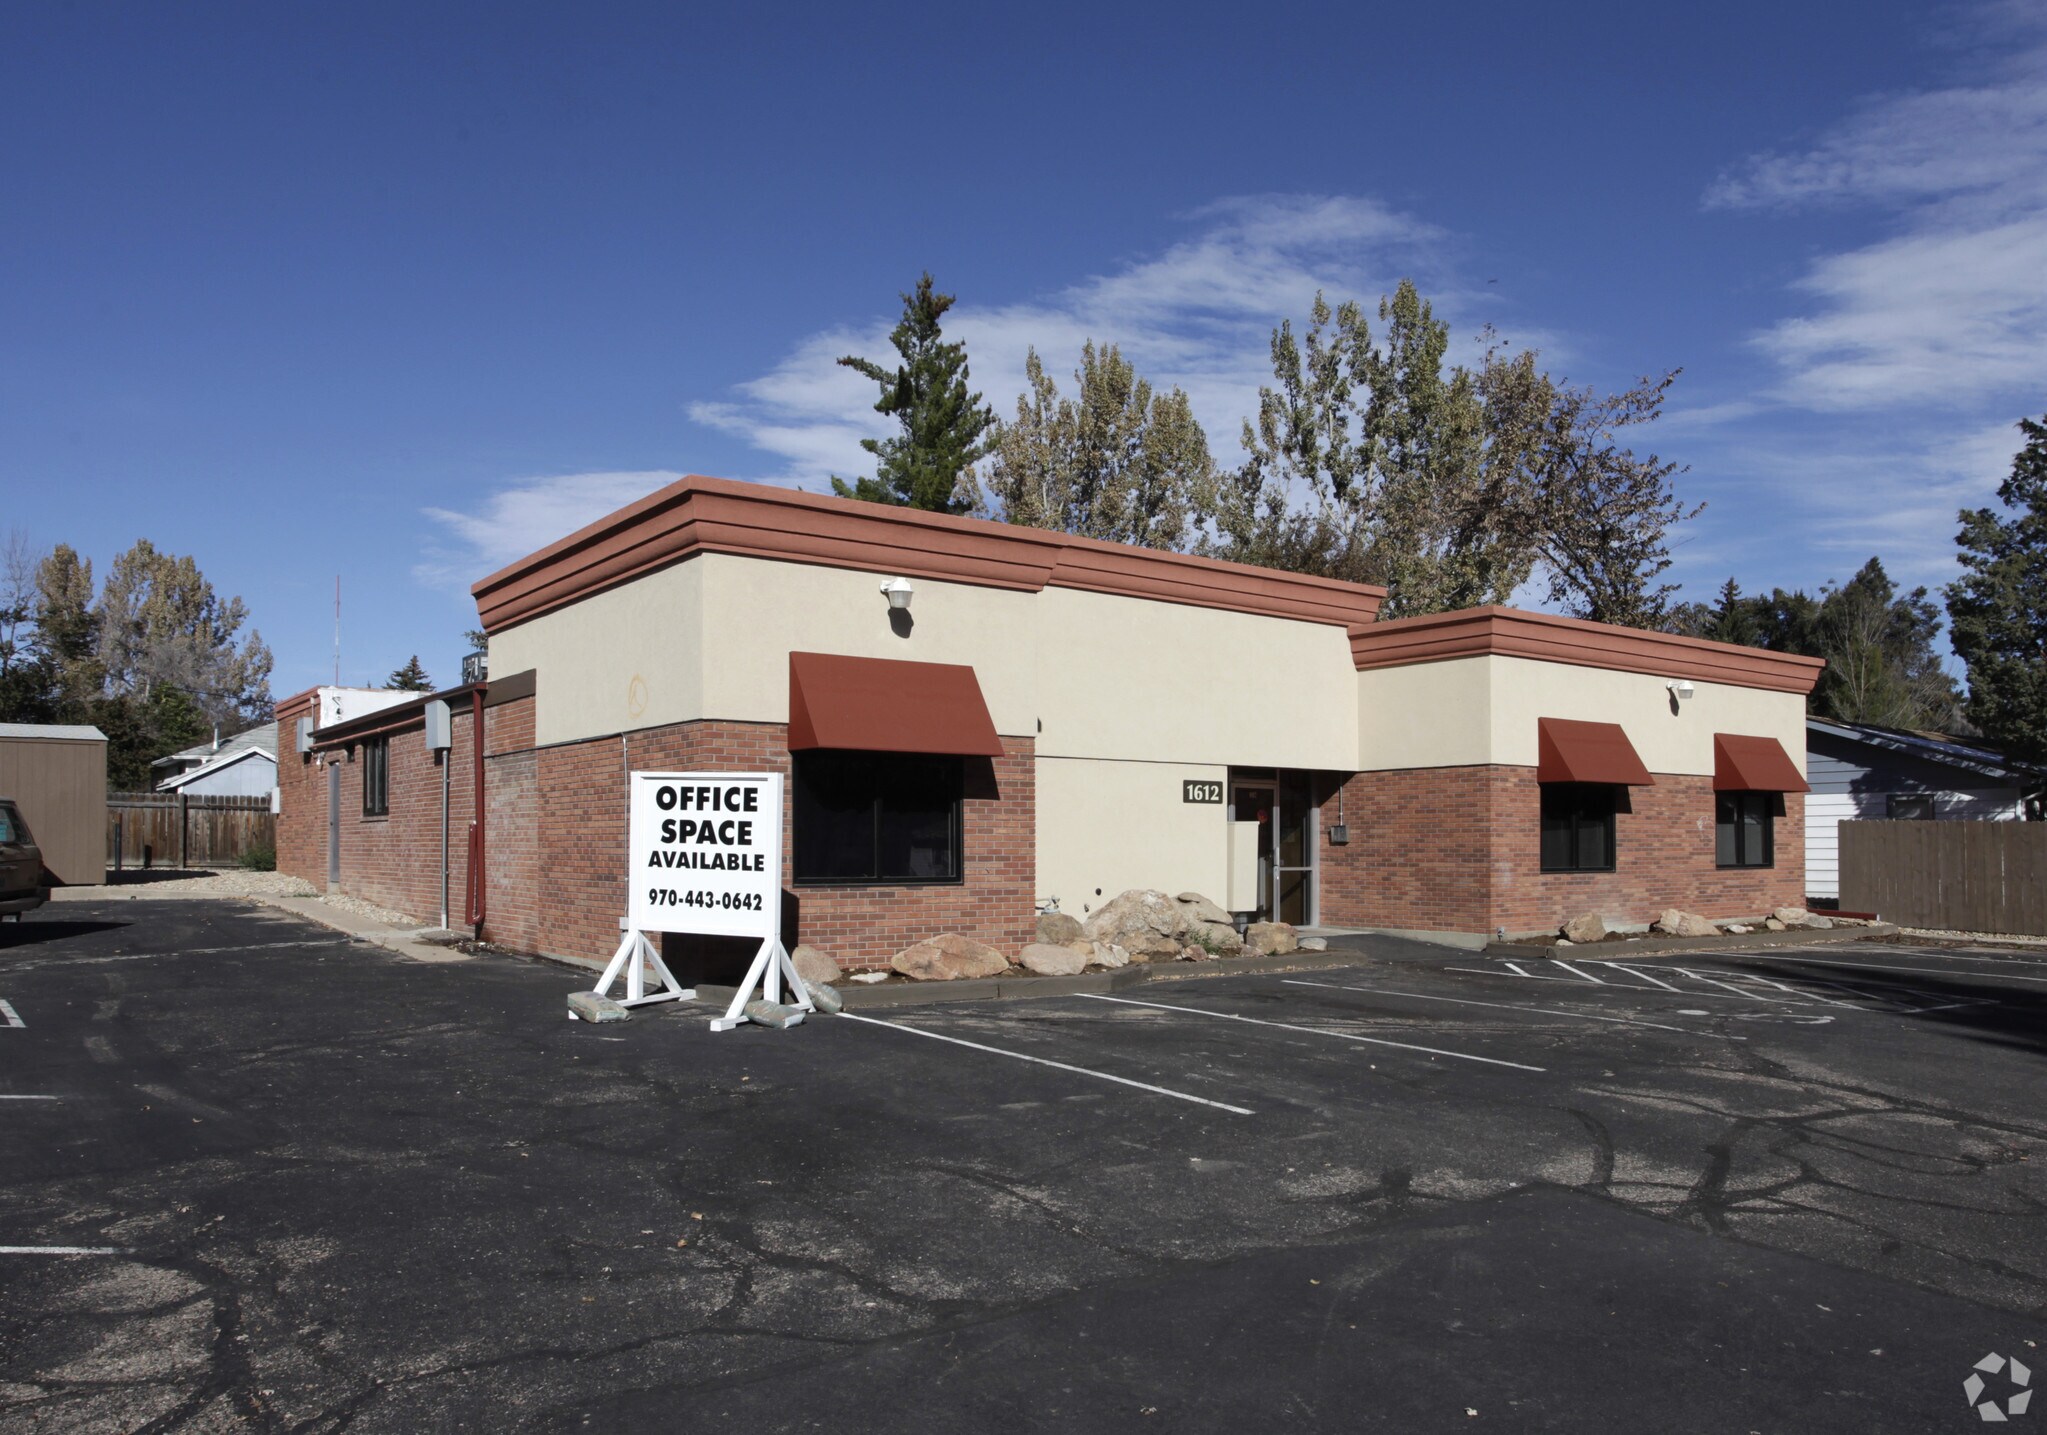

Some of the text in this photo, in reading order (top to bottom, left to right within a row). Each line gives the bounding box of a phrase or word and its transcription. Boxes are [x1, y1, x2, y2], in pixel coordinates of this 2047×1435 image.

[655, 785, 758, 812] OFFICE
[1186, 784, 1220, 801] 1612
[660, 818, 753, 846] SPACE
[647, 850, 765, 872] AVAILABLE
[648, 888, 763, 911] 970-443-0642
